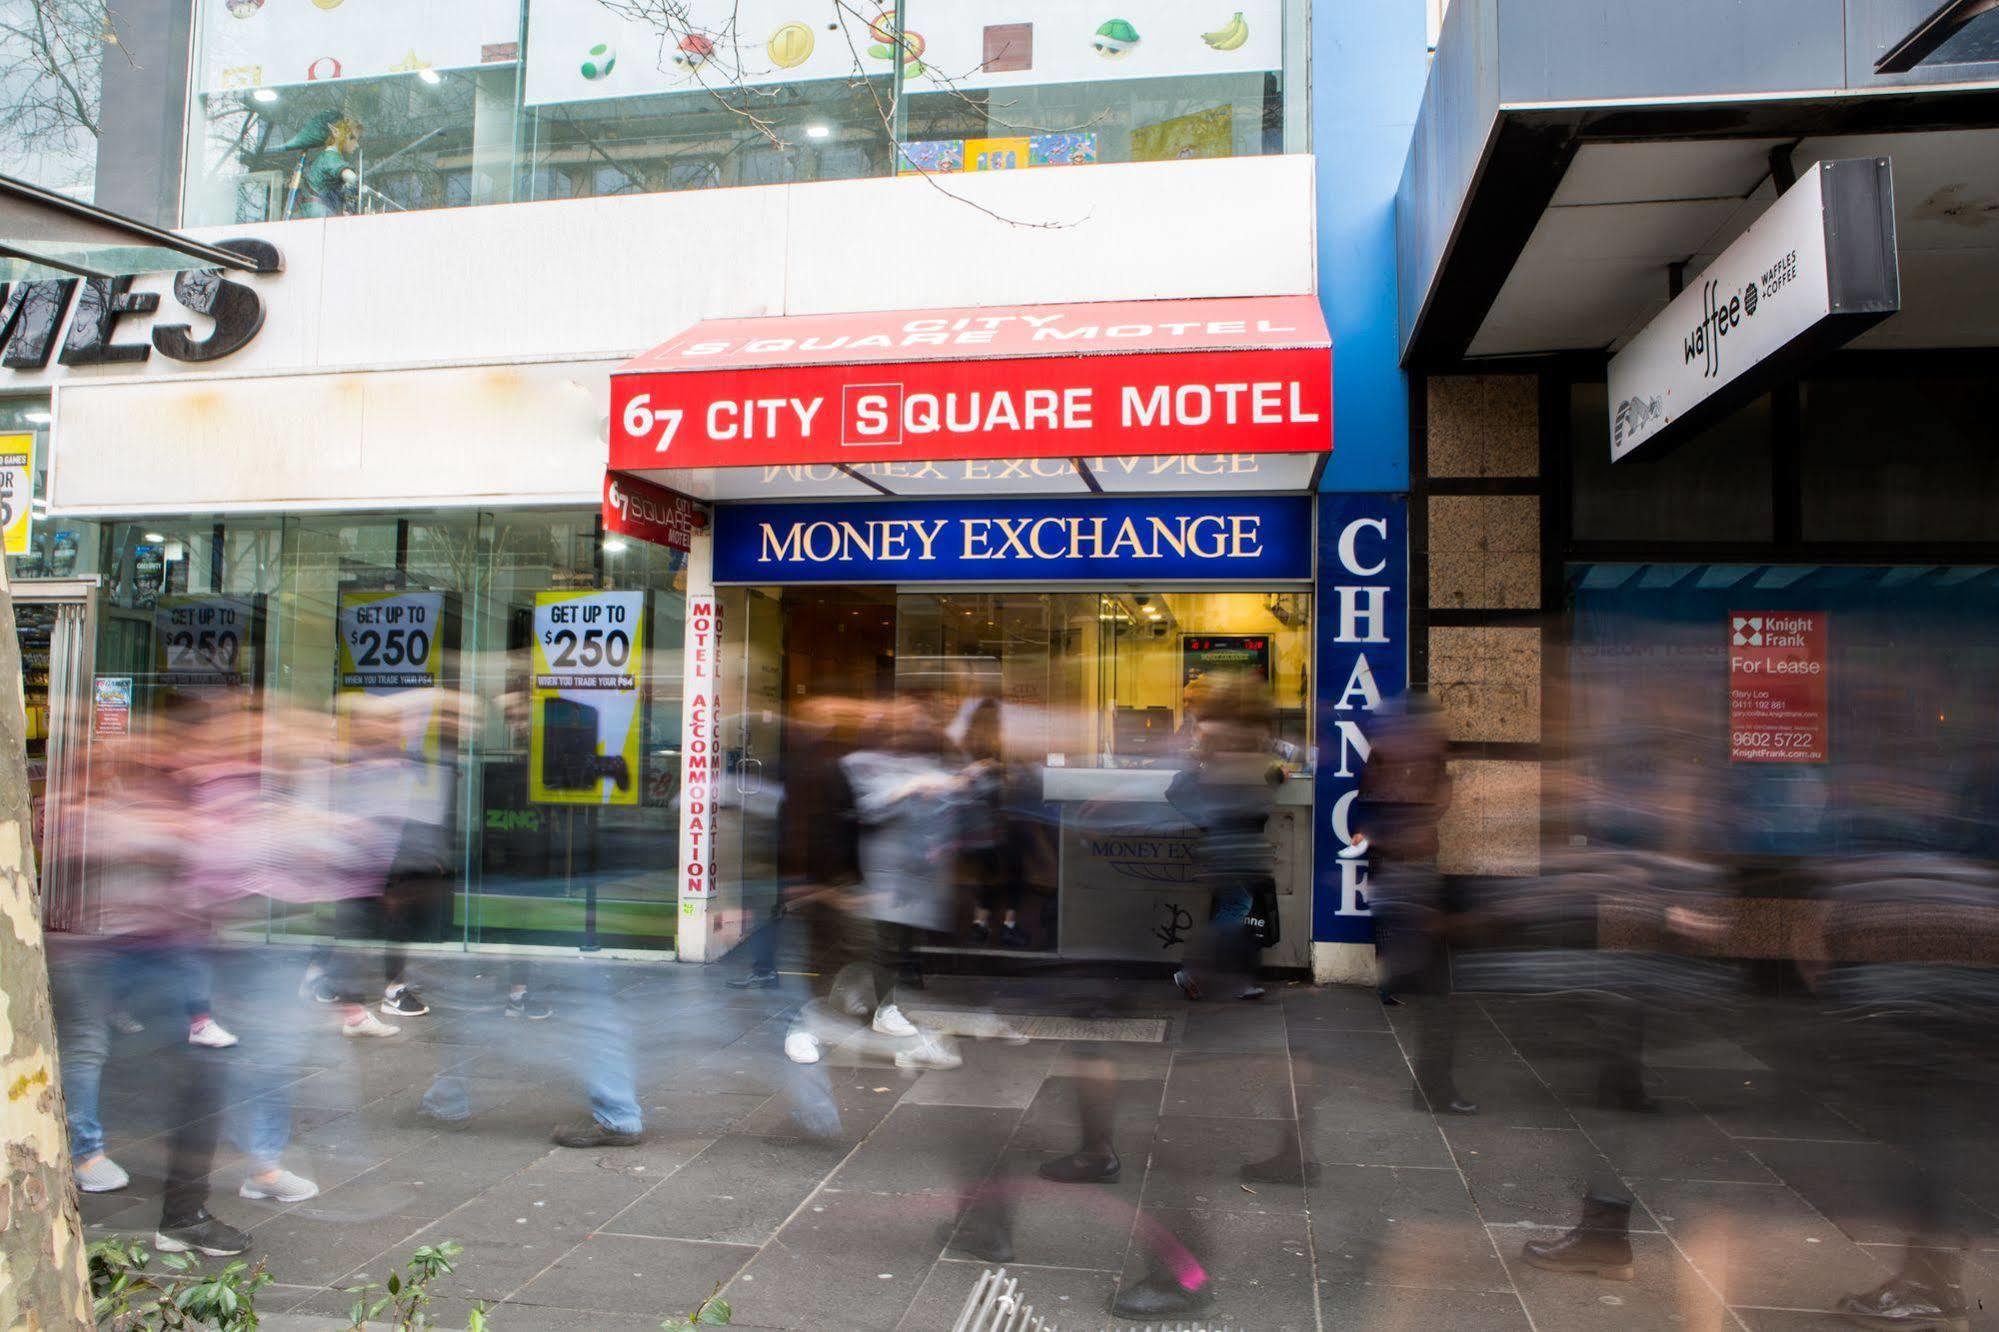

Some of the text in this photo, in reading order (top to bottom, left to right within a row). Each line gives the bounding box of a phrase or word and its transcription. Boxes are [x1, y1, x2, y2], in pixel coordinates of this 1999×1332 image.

[1761, 250, 1797, 287] WAFFLES
[1762, 265, 1797, 301] +COFFEE
[901, 314, 1064, 333] CITY
[1684, 279, 1740, 378] waffee
[681, 319, 1297, 356] SQUARE MOTEL
[623, 381, 1319, 452] 67 CITY SQUARE MOTEL
[4, 455, 27, 465] GAMES
[609, 480, 629, 521] 67
[631, 495, 692, 533] SQUARE
[668, 528, 691, 548] MOTEL
[758, 514, 1264, 563] MONEY EXCHANGE
[171, 608, 236, 625] GET UP TO
[357, 606, 426, 624] GET UP TO
[551, 605, 626, 624] GET UP TO
[1765, 617, 1813, 634] Knight
[166, 630, 239, 667] $250
[351, 629, 430, 666] $250
[545, 629, 630, 668] $250
[692, 603, 712, 677] MOTEL
[1766, 633, 1805, 647] Frank
[1732, 657, 1820, 674] For Lease
[364, 675, 377, 685] YOU
[378, 675, 398, 685] TRADE
[400, 676, 417, 685] YOUR
[537, 676, 557, 687] WHEN
[558, 676, 573, 687] YOU
[574, 676, 597, 687] TRADE
[598, 676, 617, 687] YOUR
[1732, 701, 1752, 709] 0411
[1755, 701, 1770, 709] 192
[709, 604, 724, 892] MOTEL ACCOMMODATION
[1732, 732, 1812, 748] 9602 5722
[1732, 749, 1821, 759] KnightFrank.com.au
[687, 694, 707, 892] ACCOMMODATION
[1092, 841, 1162, 858] MONEY
